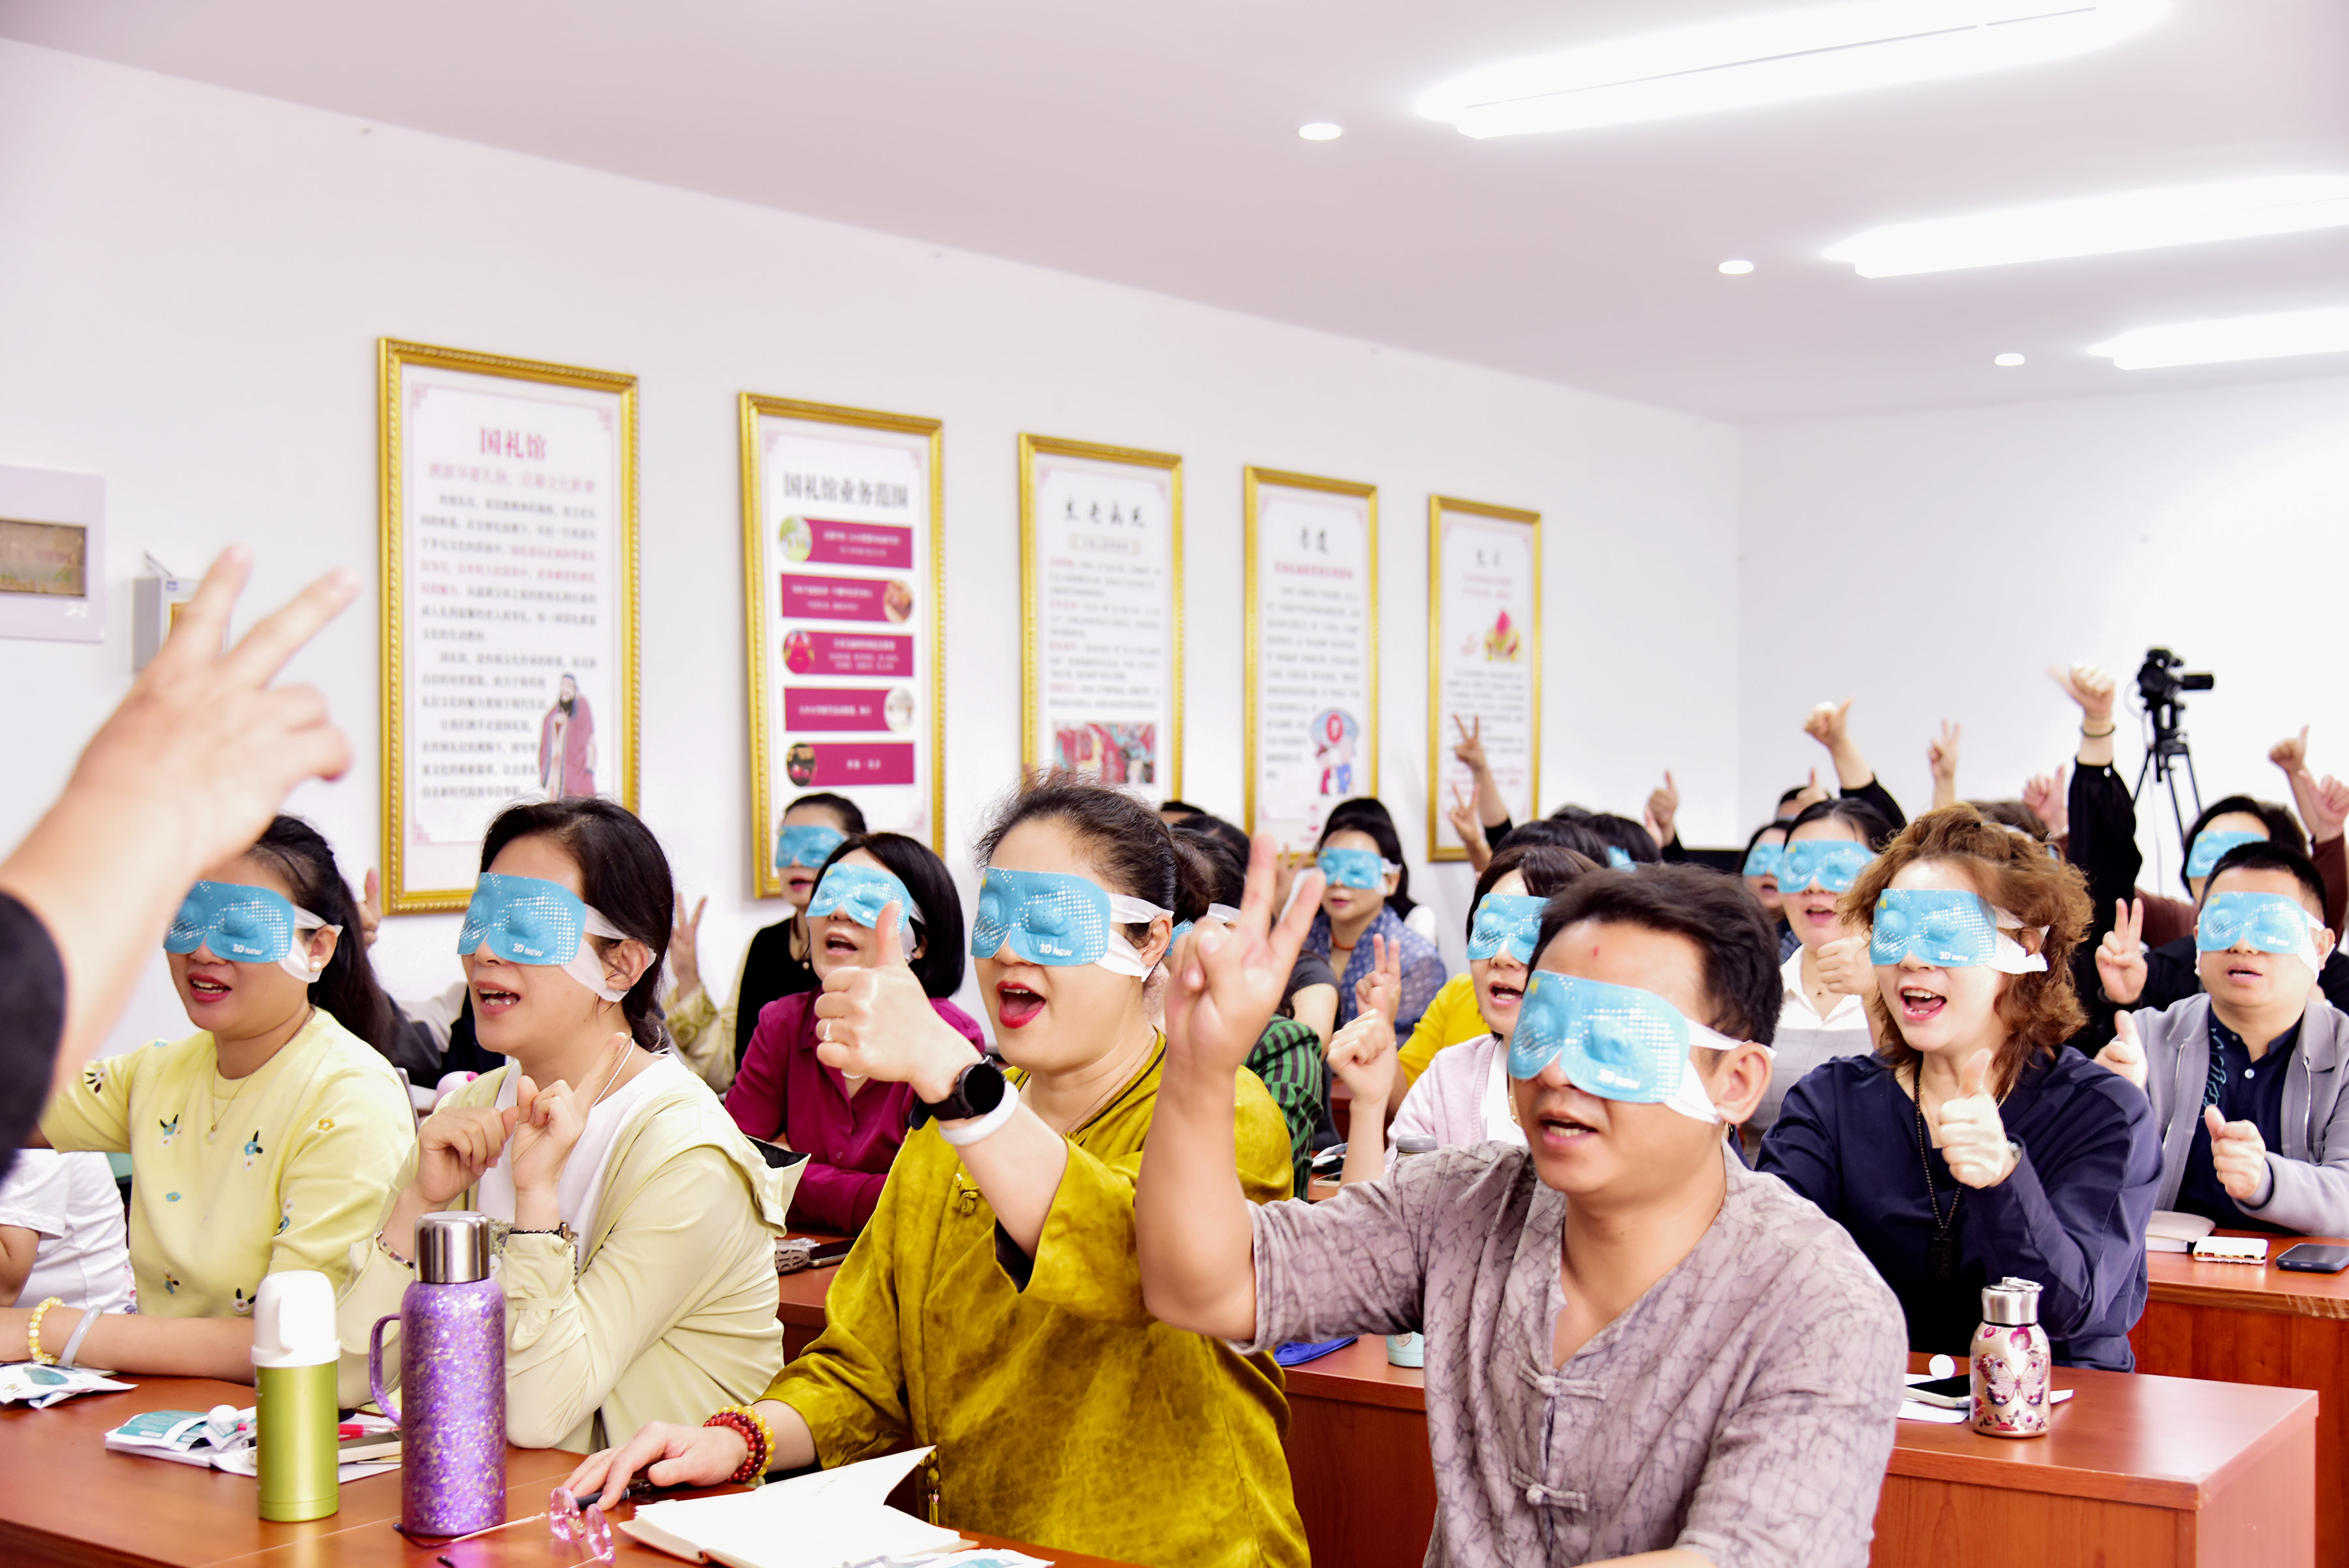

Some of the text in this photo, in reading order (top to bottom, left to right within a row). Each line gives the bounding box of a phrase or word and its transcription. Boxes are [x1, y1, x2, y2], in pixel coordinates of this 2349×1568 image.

[480, 429, 546, 459] 国礼馆
[784, 472, 910, 509] 国礼馆业务范围
[232, 944, 245, 953] 3D
[513, 943, 525, 953] 3D
[1039, 944, 1073, 957] 3D NEW
[1939, 951, 1952, 960] 3D
